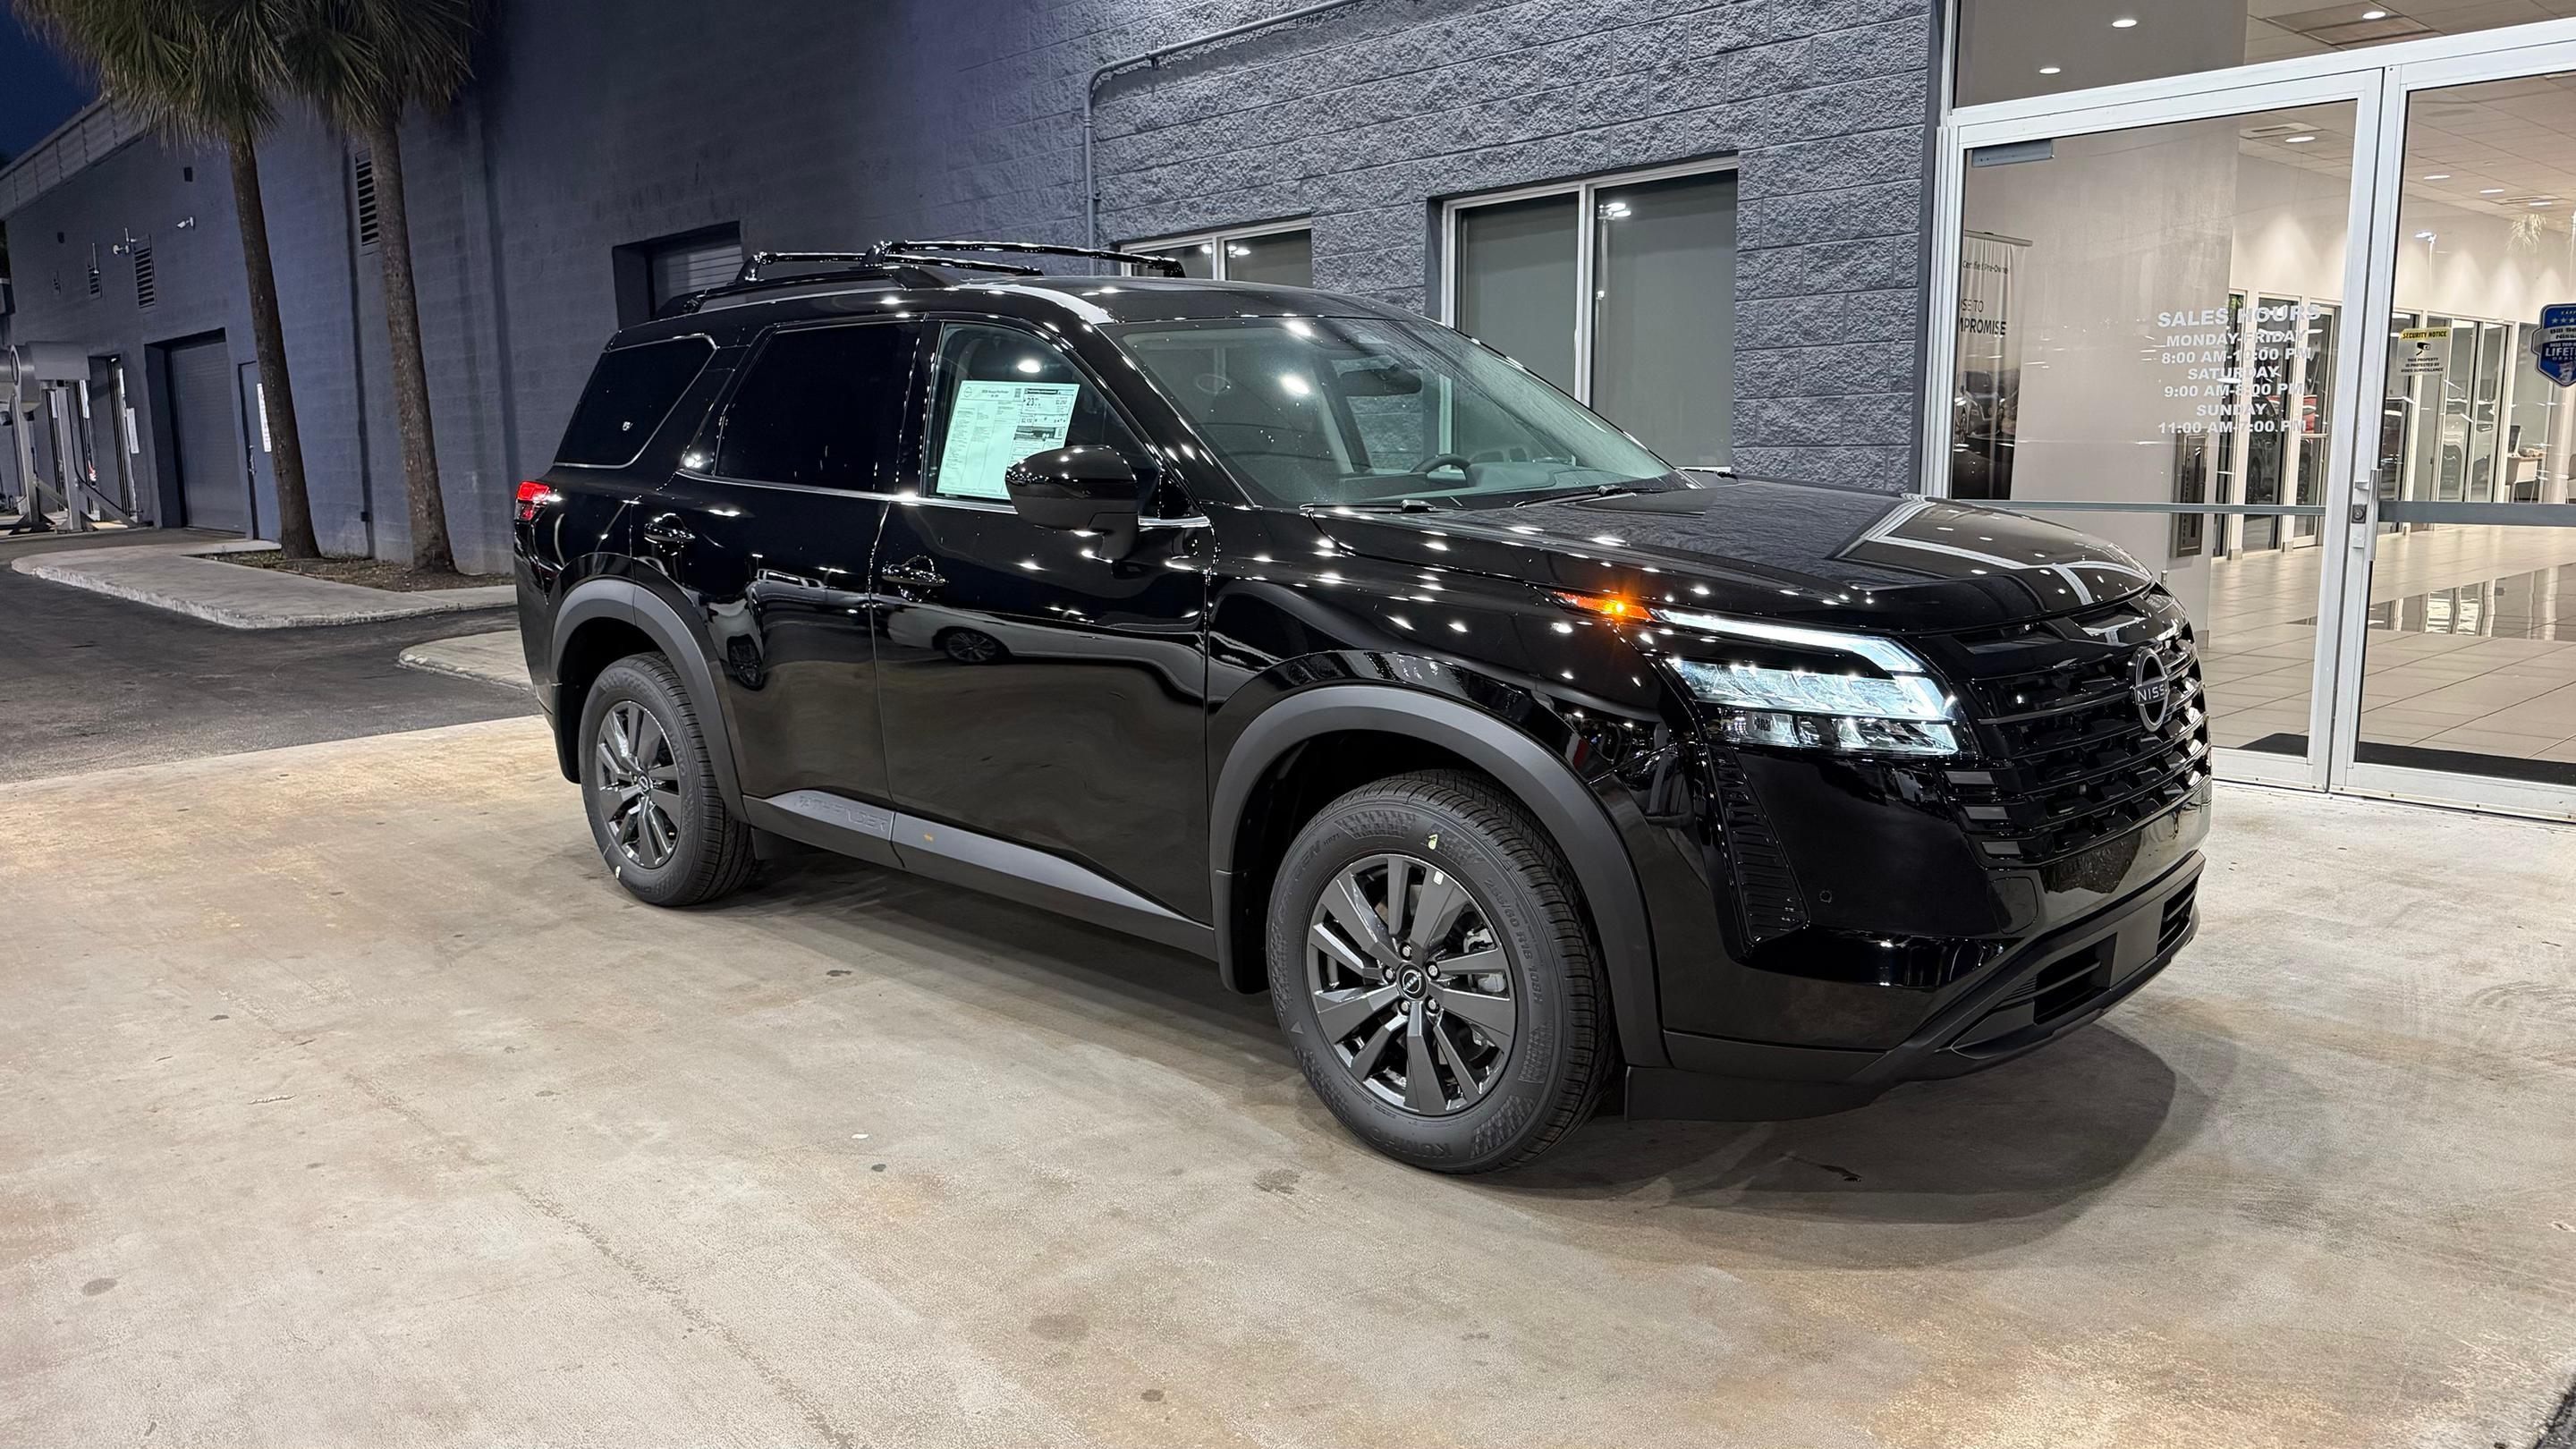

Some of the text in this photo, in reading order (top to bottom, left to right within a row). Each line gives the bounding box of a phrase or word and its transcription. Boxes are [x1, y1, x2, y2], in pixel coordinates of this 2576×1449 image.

[1961, 299, 1984, 313] SE TO
[2157, 304, 2322, 327] SALES HOURS
[2165, 330, 2309, 348] MONDAY-FRIDAY
[2161, 352, 2196, 364] 8:00
[2284, 347, 2311, 360] PM
[2188, 366, 2280, 381] SATURDAY
[2164, 386, 2198, 398] 9:00
[2276, 382, 2304, 395] PM
[2196, 402, 2267, 417] SUNDAY
[2158, 421, 2201, 434] 11:00
[2281, 419, 2307, 432] PM
[2137, 683, 2168, 702] NISS
